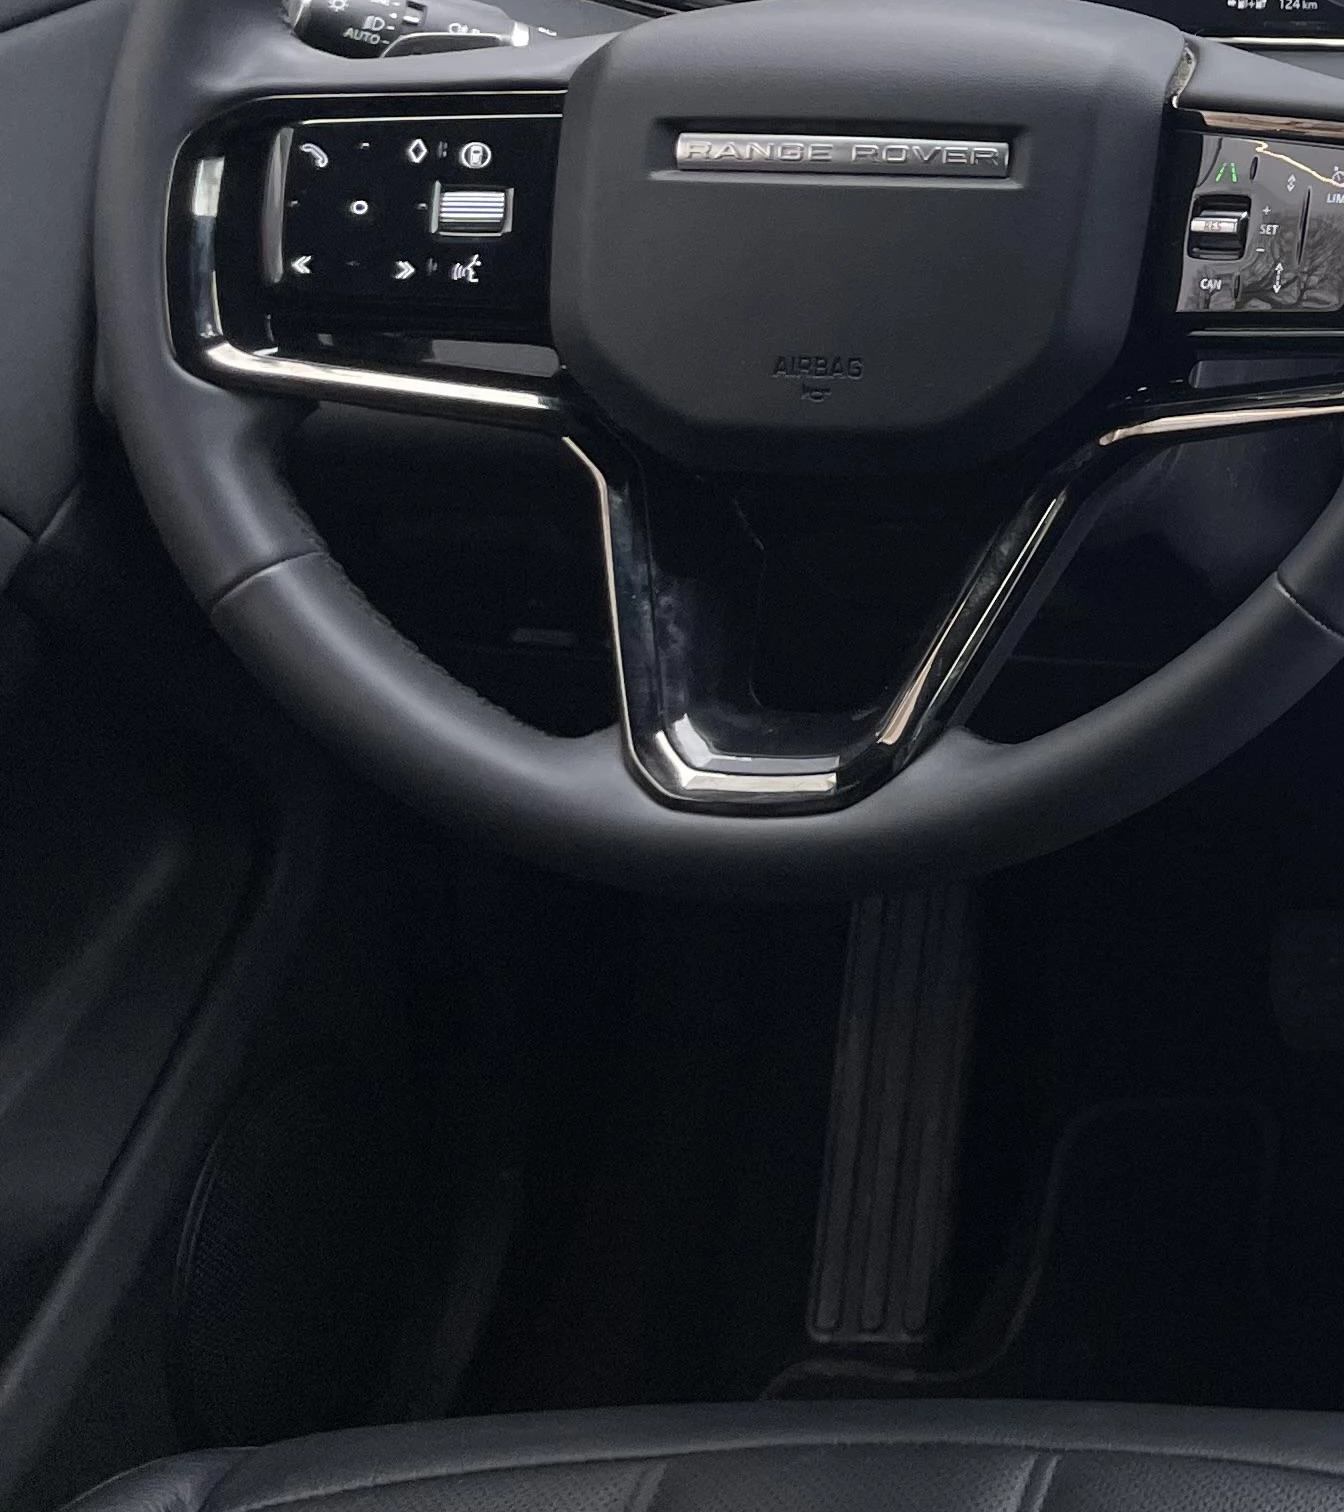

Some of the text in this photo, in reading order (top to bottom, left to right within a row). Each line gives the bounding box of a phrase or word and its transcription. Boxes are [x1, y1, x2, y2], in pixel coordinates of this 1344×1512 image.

[1302, 0, 1318, 10] km
[343, 27, 381, 45] AUTO
[687, 141, 999, 166] RANGE ROVER
[1259, 224, 1279, 235] SET
[1200, 278, 1222, 290] CAN
[772, 356, 864, 380] AIRBAG
